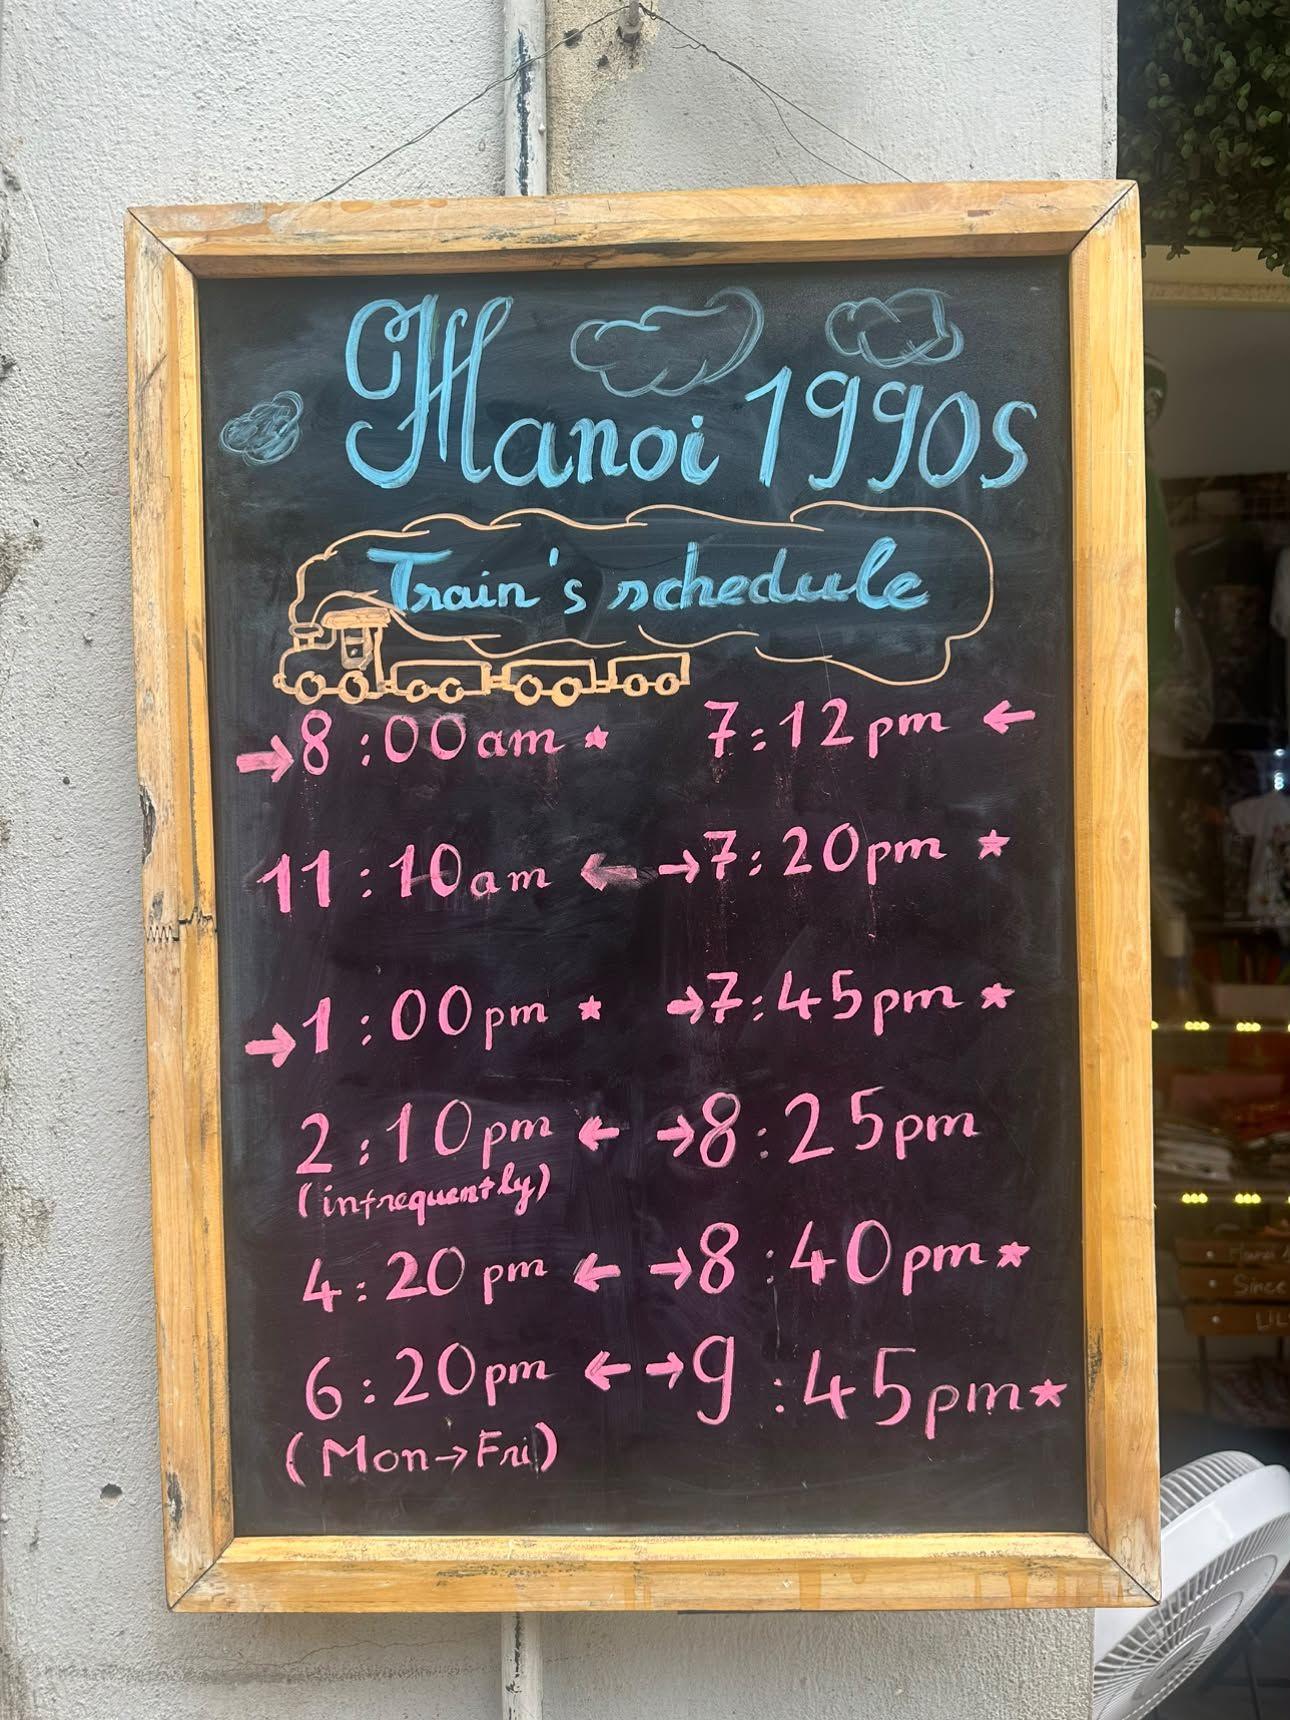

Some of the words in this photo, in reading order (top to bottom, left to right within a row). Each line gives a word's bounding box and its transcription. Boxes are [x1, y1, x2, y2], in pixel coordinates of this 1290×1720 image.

[345, 293, 720, 490] Hanoi
[744, 365, 1038, 494] 1990s
[606, 535, 930, 612] schedule
[297, 1161, 551, 1226] (infrequently)
